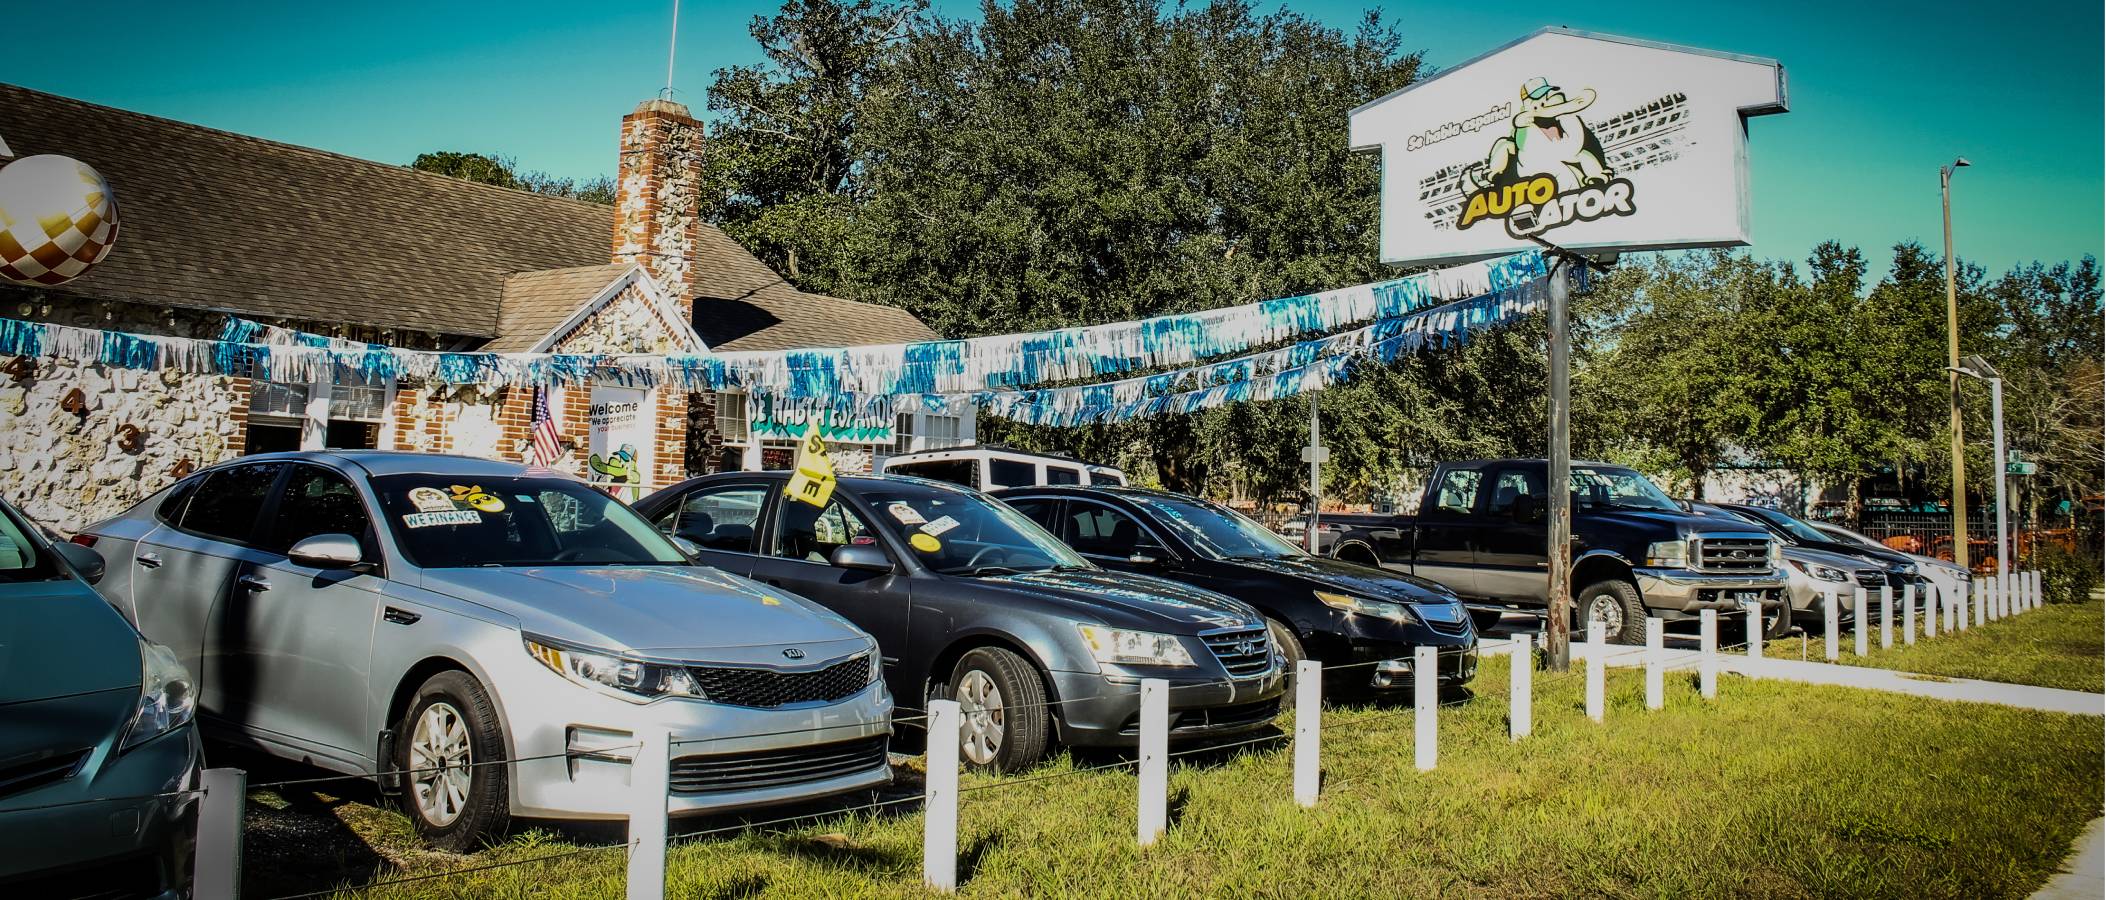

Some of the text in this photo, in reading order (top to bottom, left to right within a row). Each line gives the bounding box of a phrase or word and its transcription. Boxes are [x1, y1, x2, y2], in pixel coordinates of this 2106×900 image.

[1407, 102, 1511, 151] Se habla español
[1459, 176, 1556, 227] AUTO
[589, 402, 638, 417] Welcome
[592, 417, 601, 425] We
[407, 511, 479, 526] WE FINANCE
[784, 649, 806, 658] KIA
